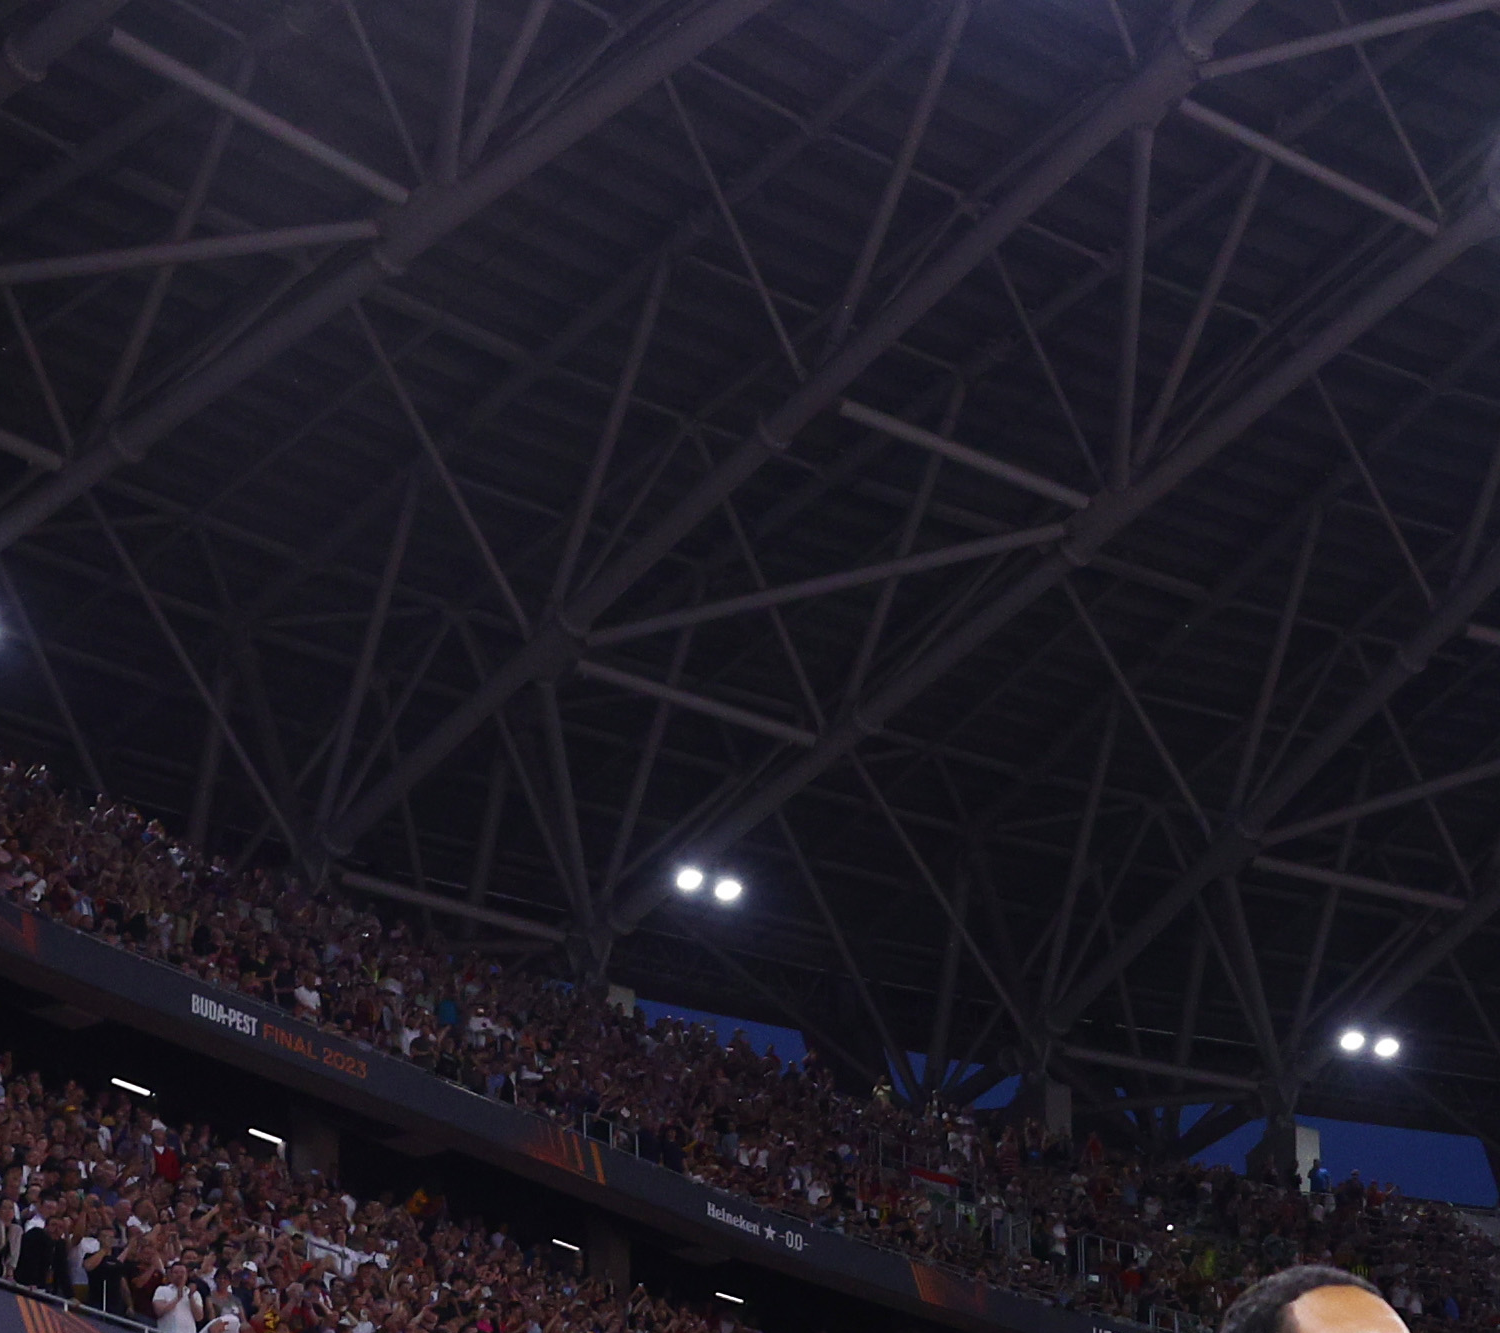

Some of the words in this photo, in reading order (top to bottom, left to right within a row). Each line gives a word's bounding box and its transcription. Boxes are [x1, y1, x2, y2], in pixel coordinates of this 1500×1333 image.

[262, 1024, 318, 1061] FINAL
[322, 1046, 369, 1079] 2023
[706, 1201, 760, 1237] Heineken
